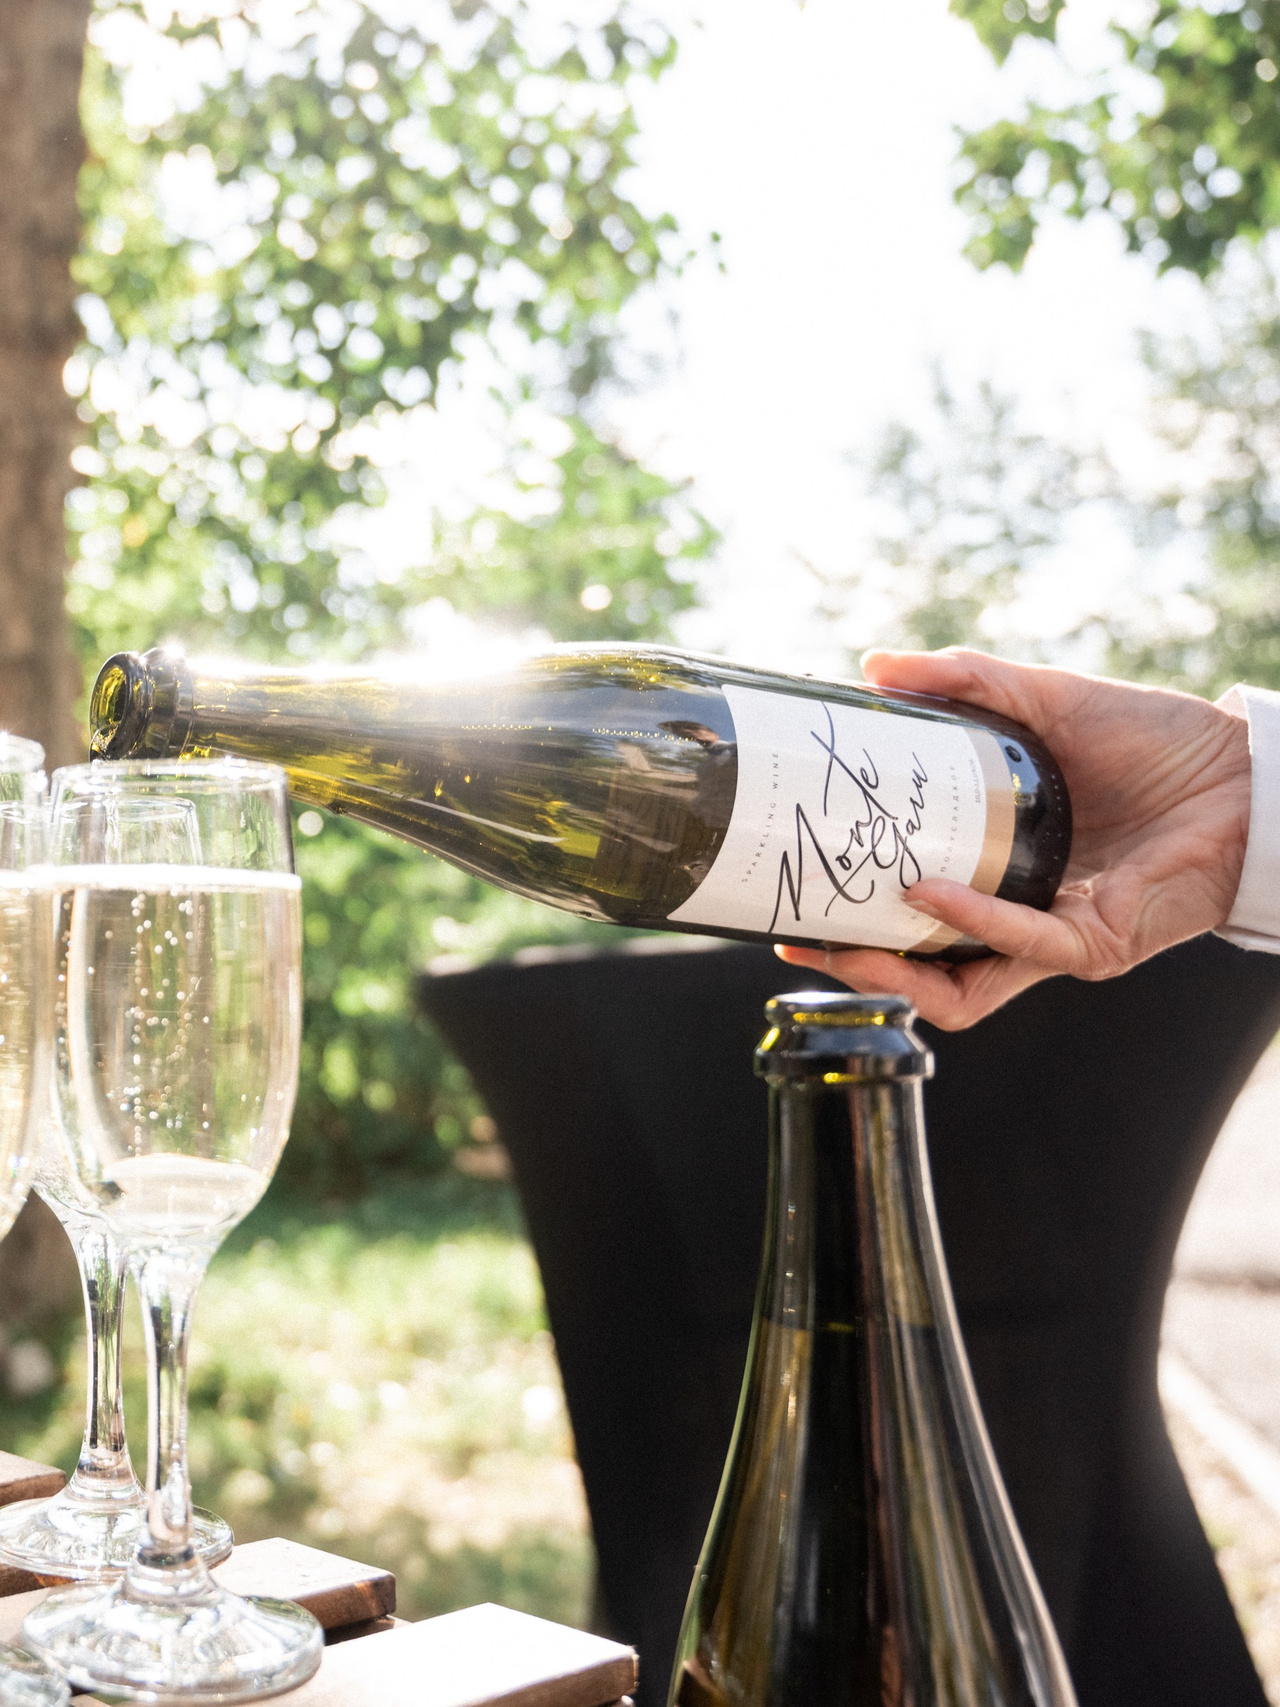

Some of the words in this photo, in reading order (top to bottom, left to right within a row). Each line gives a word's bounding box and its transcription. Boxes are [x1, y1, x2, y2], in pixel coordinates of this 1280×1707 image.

[741, 802, 777, 883] SPARKLING
[772, 753, 780, 789] WINE
[768, 701, 898, 933] Monte
[939, 766, 959, 873] ПОЛУСЛАДКОЕ
